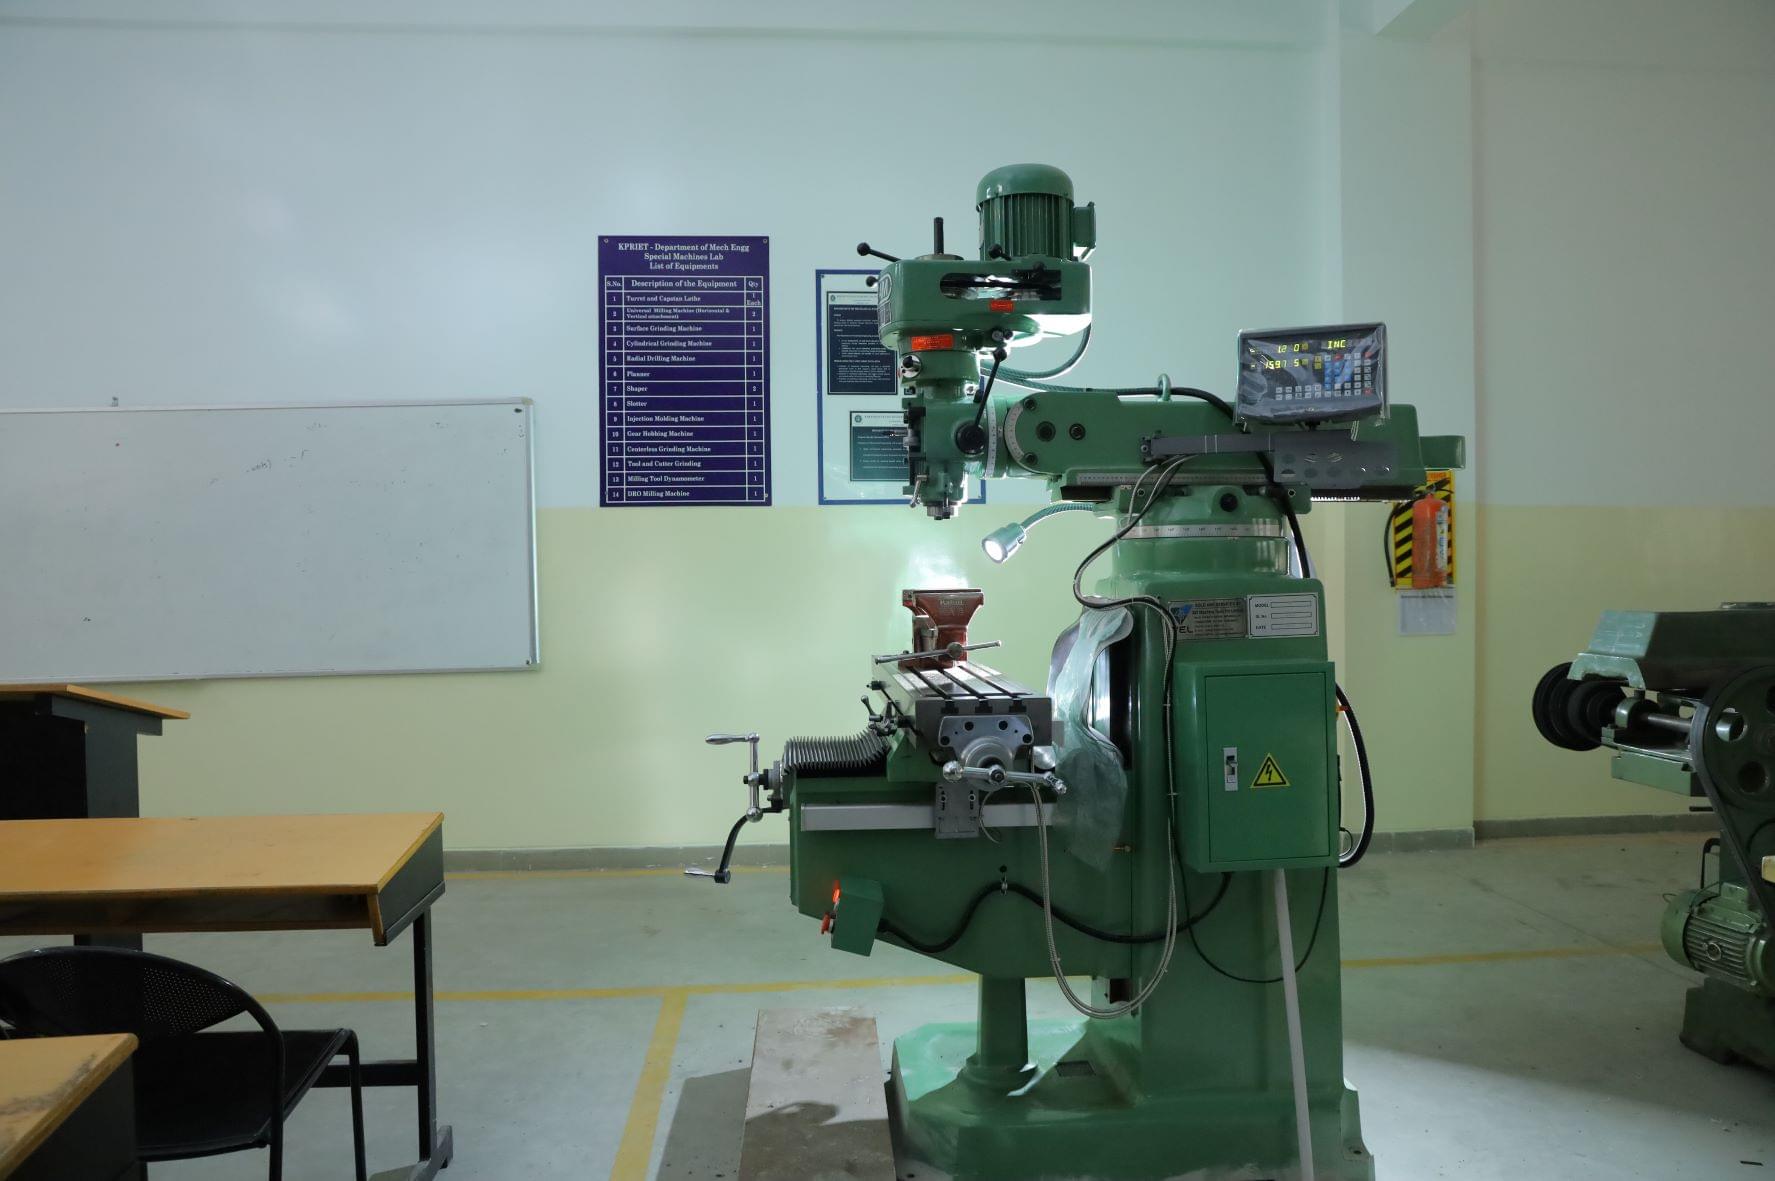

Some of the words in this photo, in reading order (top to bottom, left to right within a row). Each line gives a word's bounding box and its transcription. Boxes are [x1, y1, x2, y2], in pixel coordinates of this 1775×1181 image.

[655, 243, 698, 252] Department
[731, 244, 750, 252] Engg
[644, 253, 672, 261] Special
[649, 262, 664, 270] List
[666, 262, 673, 270] of
[675, 263, 718, 271] Equipments
[632, 280, 674, 288] Description
[698, 280, 737, 288] Equipment
[1328, 340, 1346, 349] INC
